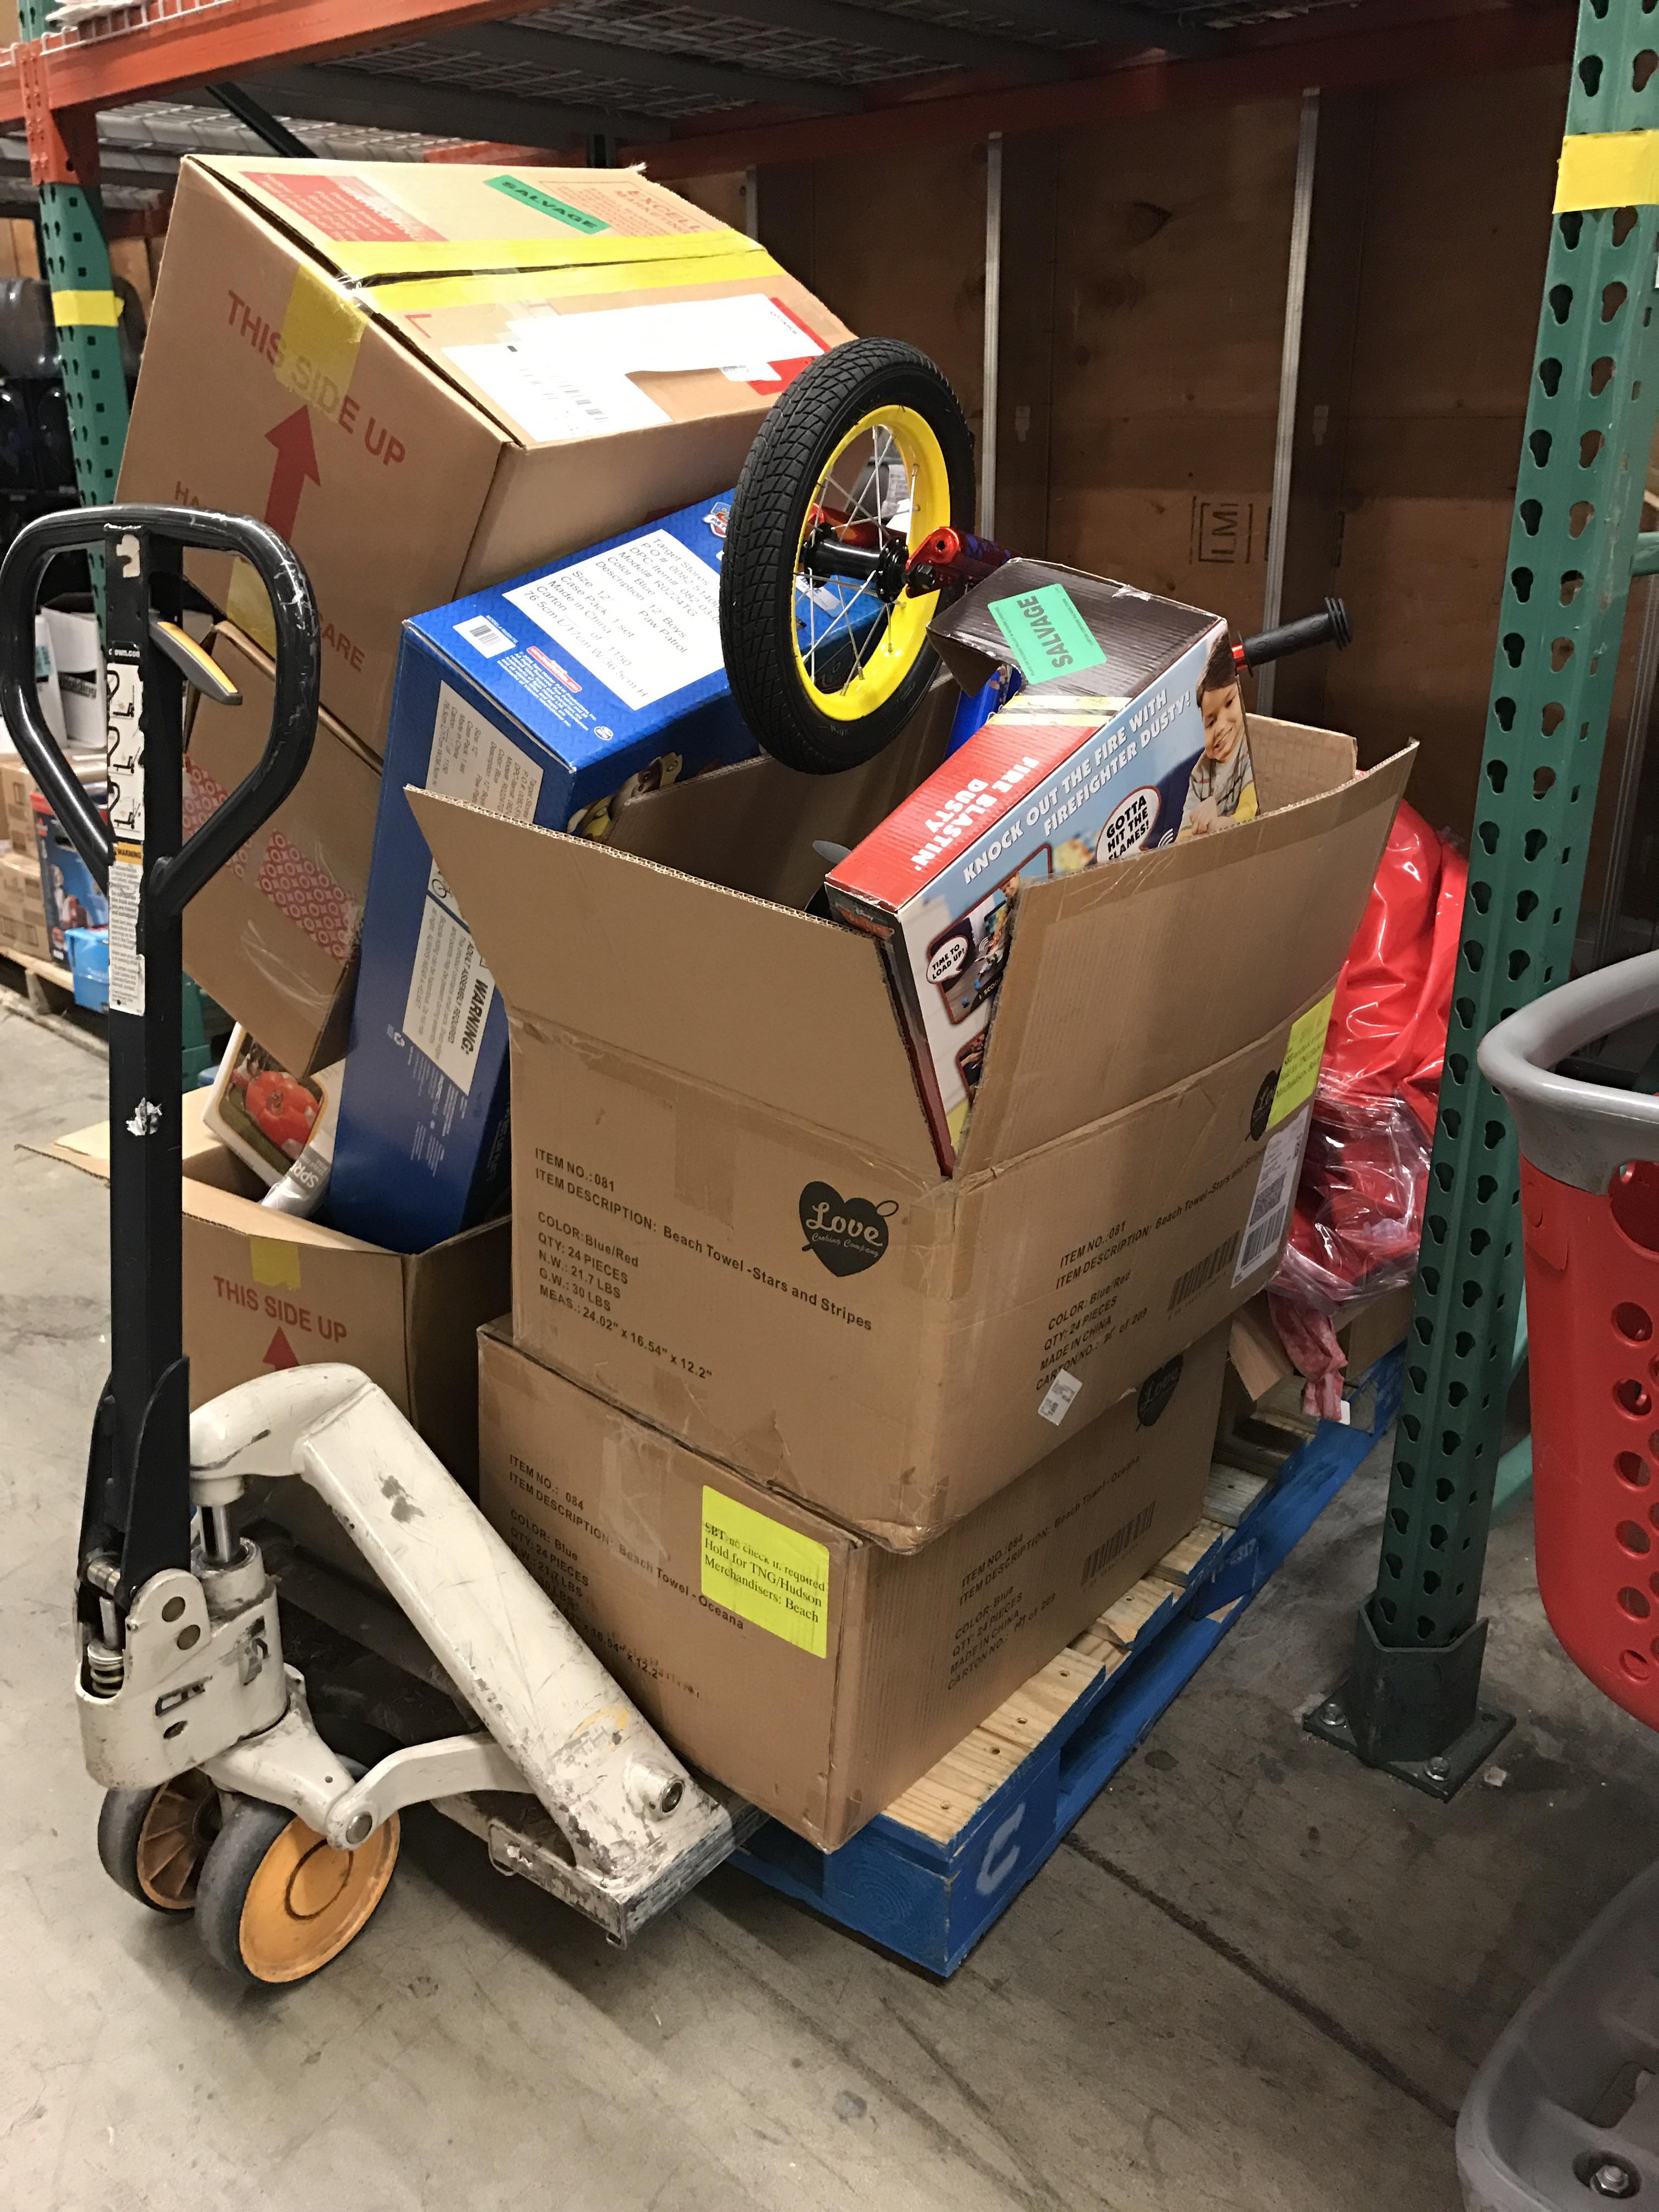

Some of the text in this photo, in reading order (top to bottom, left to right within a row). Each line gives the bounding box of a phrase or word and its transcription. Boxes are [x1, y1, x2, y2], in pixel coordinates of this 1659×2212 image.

[501, 180, 598, 229] SALVAGE
[228, 290, 407, 466] THIS SIDE UP
[572, 571, 593, 588] Size
[608, 557, 655, 595] Color Blue
[618, 552, 652, 577] Model#
[653, 538, 709, 585] Target Stores
[537, 586, 567, 611] Carton
[548, 580, 574, 602] Made
[585, 611, 612, 634] China
[561, 576, 635, 637] Case Pack set
[595, 561, 645, 601] Description
[663, 617, 686, 638] Boys
[319, 614, 365, 673] ARE
[638, 610, 688, 652] Paw Patrol
[1017, 595, 1074, 669] SALVAGE
[964, 688, 1169, 884] KNOCK OUT THE FIRE WITH
[991, 756, 1040, 793] FIRE
[1043, 690, 1192, 837] FIREFIGHTER DUSTY!
[924, 778, 989, 833] DUSTY
[1107, 795, 1147, 838] GOTTA
[1108, 806, 1148, 853] HIT THE
[117, 848, 142, 859] WARNING
[932, 944, 960, 970] TIME TO
[932, 947, 965, 980] LOAD UP!
[460, 978, 489, 1058] WARNING:
[535, 1147, 564, 1170] ITEM
[535, 1167, 564, 1190] ITEM
[567, 1182, 657, 1232] DESCRIPTION:
[663, 1224, 702, 1254] Beach
[707, 1244, 744, 1272] Towel
[791, 1286, 817, 1306] and
[821, 1297, 872, 1331] Stripes
[805, 1201, 884, 1246] Love
[1056, 1189, 1207, 1290] ITEM DESCRIPTION: Beach Towel
[538, 1232, 628, 1284] QTY: 24 PIECES
[539, 1249, 621, 1299] N.W.: 21.7 LBS
[1060, 1244, 1085, 1269] ITEM
[213, 1276, 347, 1345] THIS SIDE UP
[539, 1267, 611, 1312] G.W.: 30 LBS
[1048, 1299, 1087, 1330] COLOR:
[539, 1284, 713, 1379] MEAS.: 24.02" x 16.54" x 12.2"
[1040, 1344, 1069, 1372] MADE
[1070, 1335, 1081, 1351] IN
[1082, 1315, 1111, 1342] CHINA
[1045, 1329, 1068, 1351] QTY:
[1069, 1319, 1081, 1335] 24
[1082, 1295, 1118, 1327] PIECES
[1036, 1355, 1077, 1391] CARTON
[510, 1454, 584, 1510] ITEM NO.: 084
[510, 1471, 534, 1495] ITEM
[619, 1543, 653, 1573] Beach
[656, 1567, 690, 1596] Towel
[698, 1595, 744, 1629] Oceana
[511, 1509, 550, 1543] COLOR:
[555, 1538, 578, 1561] Blue
[511, 1526, 534, 1549] QTY:
[536, 1544, 548, 1559] 24
[550, 1553, 589, 1587] PIECES
[960, 1579, 983, 1606] ITEM
[1054, 1503, 1081, 1528] Beach
[561, 1576, 582, 1598] LBS
[704, 1538, 822, 1607] Hold for TNG/Hudson
[704, 1554, 819, 1623] Merchandisers: Beach
[785, 1566, 825, 1592] required
[962, 1561, 985, 1588] ITEM
[989, 1592, 1023, 1627] PIECES
[950, 1645, 978, 1674] MADE
[979, 1635, 990, 1650] IN
[991, 1609, 1019, 1639] CHINA
